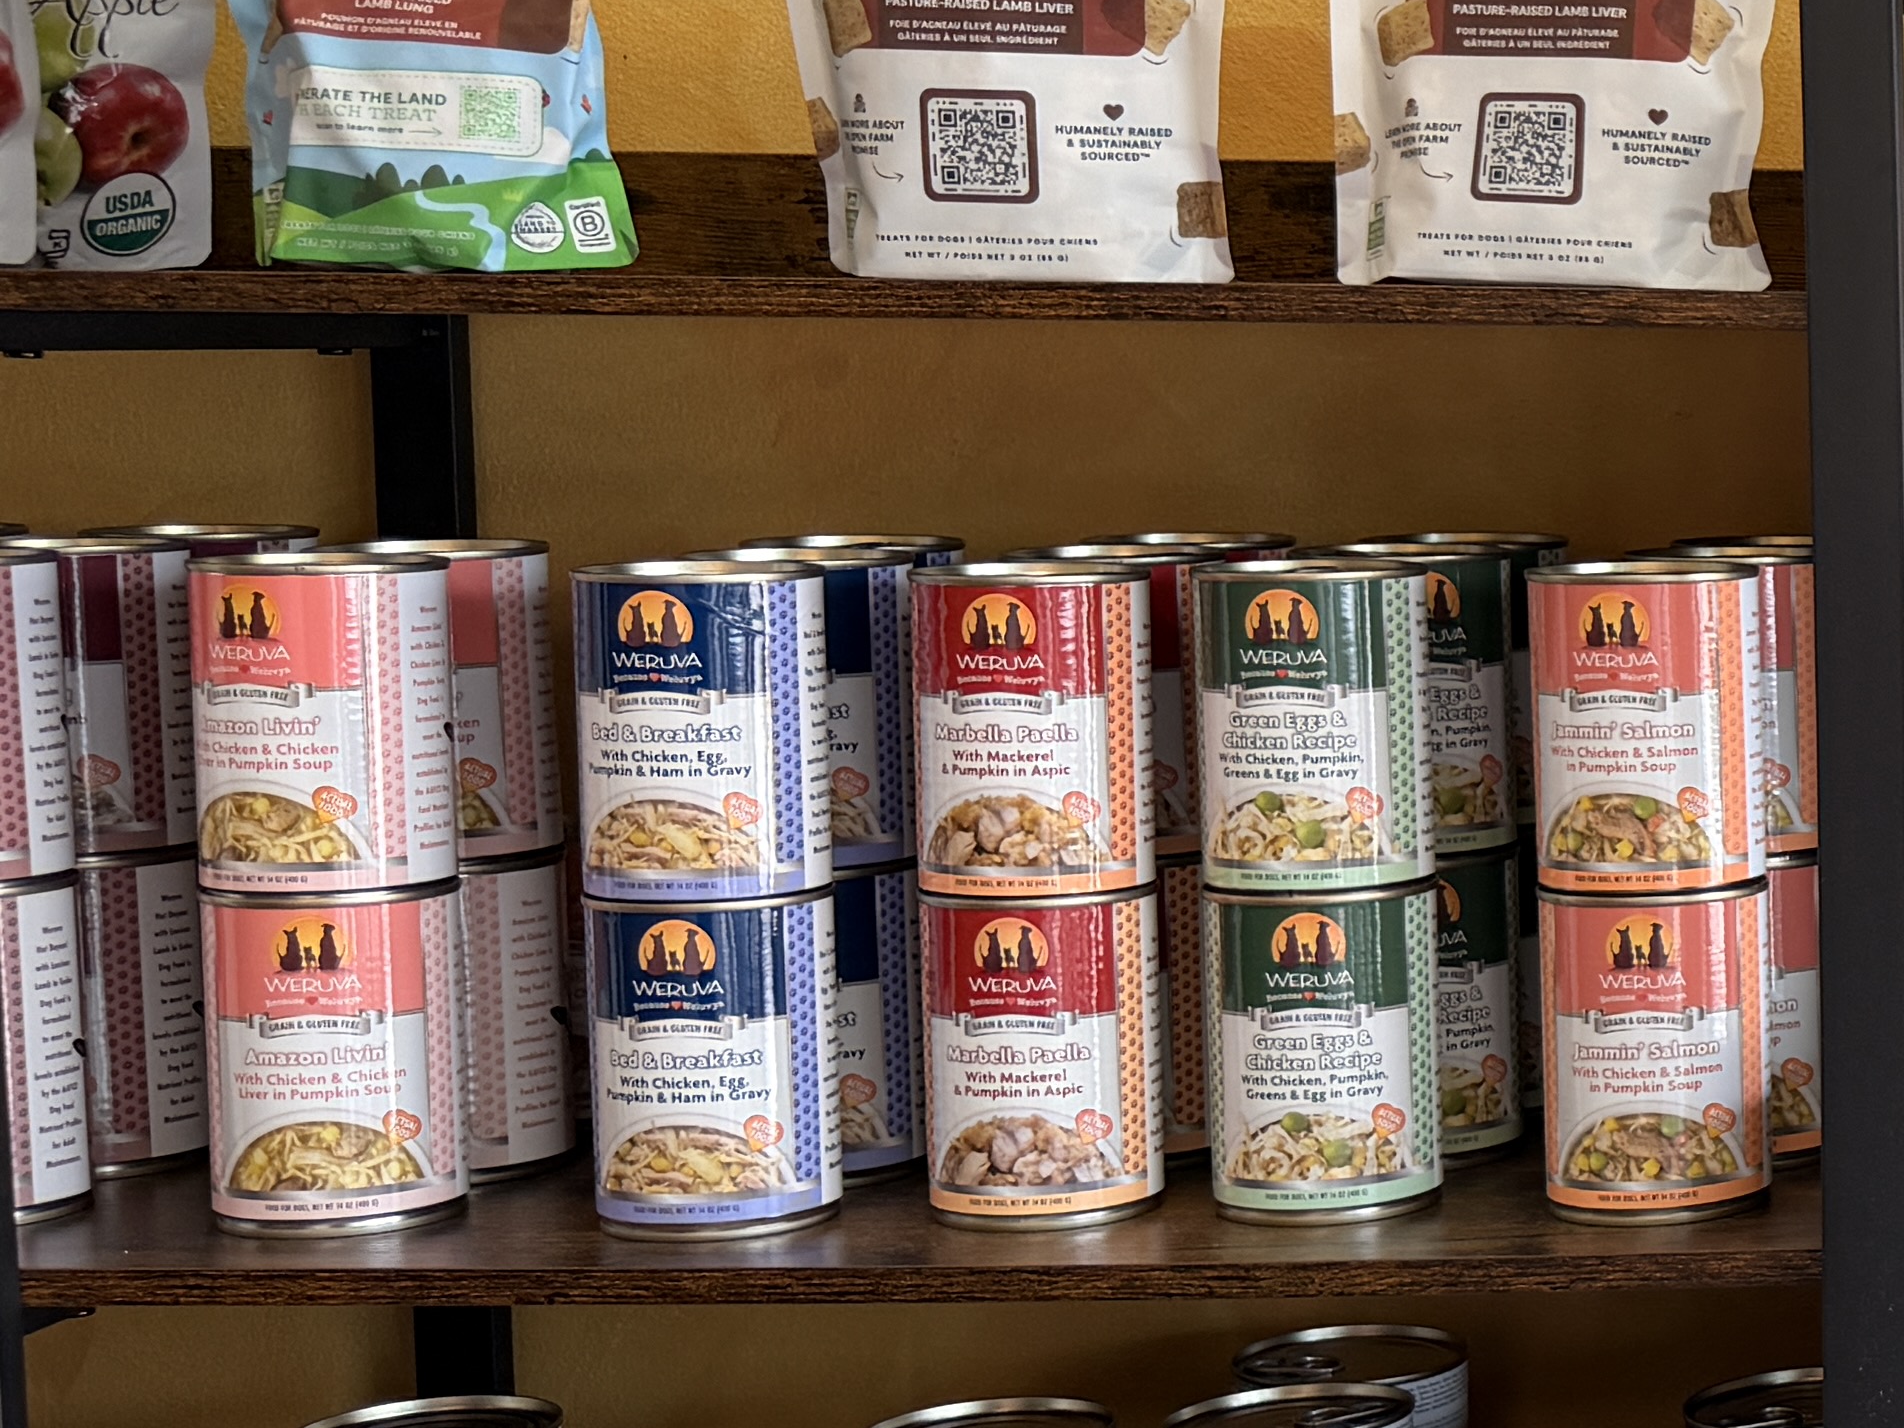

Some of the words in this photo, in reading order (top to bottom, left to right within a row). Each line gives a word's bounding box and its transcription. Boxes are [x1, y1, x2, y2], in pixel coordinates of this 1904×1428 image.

[1034, 1, 1074, 15] LIVER
[361, 88, 392, 105] THE
[397, 91, 447, 107] LAND
[1055, 125, 1122, 139] HUMANELY
[1126, 126, 1173, 139] RAISED
[104, 188, 153, 215] USDA
[95, 210, 163, 236] ORGANIC
[956, 654, 1044, 672] WERUVA
[1230, 711, 1280, 732] Green
[1286, 711, 1326, 733] Eggs
[1332, 711, 1346, 729] &
[1621, 719, 1693, 741] Salmon
[935, 723, 1023, 744] Marbella
[1028, 723, 1078, 742] Paella
[1222, 732, 1290, 752] Chicken
[1295, 730, 1356, 753] Recipe
[277, 743, 339, 755] Chicken
[264, 977, 362, 993] WERUVA
[632, 981, 724, 998] WERUVA
[245, 1048, 327, 1066] Amazon
[610, 1050, 638, 1068] Bed
[643, 1050, 656, 1067] &
[661, 1048, 762, 1067] Breakfast
[619, 1075, 652, 1090] With
